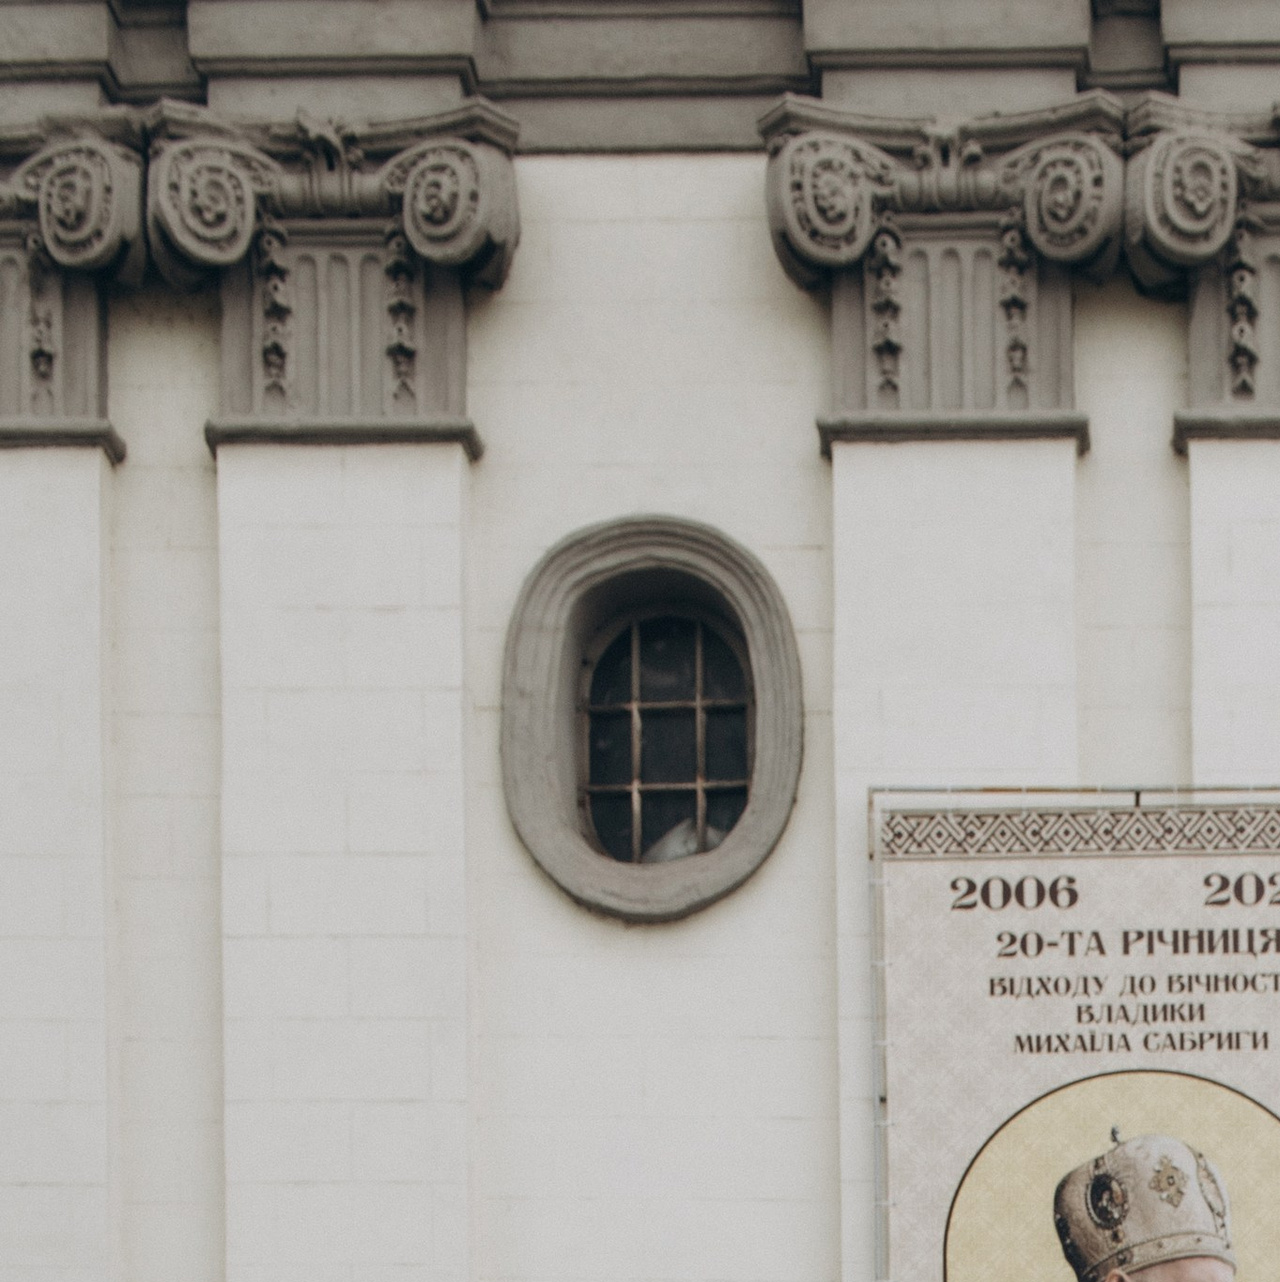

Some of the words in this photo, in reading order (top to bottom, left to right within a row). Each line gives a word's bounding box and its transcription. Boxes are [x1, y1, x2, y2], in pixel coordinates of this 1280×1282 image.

[950, 876, 1079, 910] 2006
[996, 931, 1106, 958] 20-ТА
[989, 975, 1107, 998] ВІДХОДУ
[1119, 974, 1157, 998] ДО
[1077, 1003, 1205, 1025] ВЛАДИКИ
[1014, 1030, 1132, 1054] МИХАЇЛА
[1143, 1031, 1270, 1052] САБРИГИ
